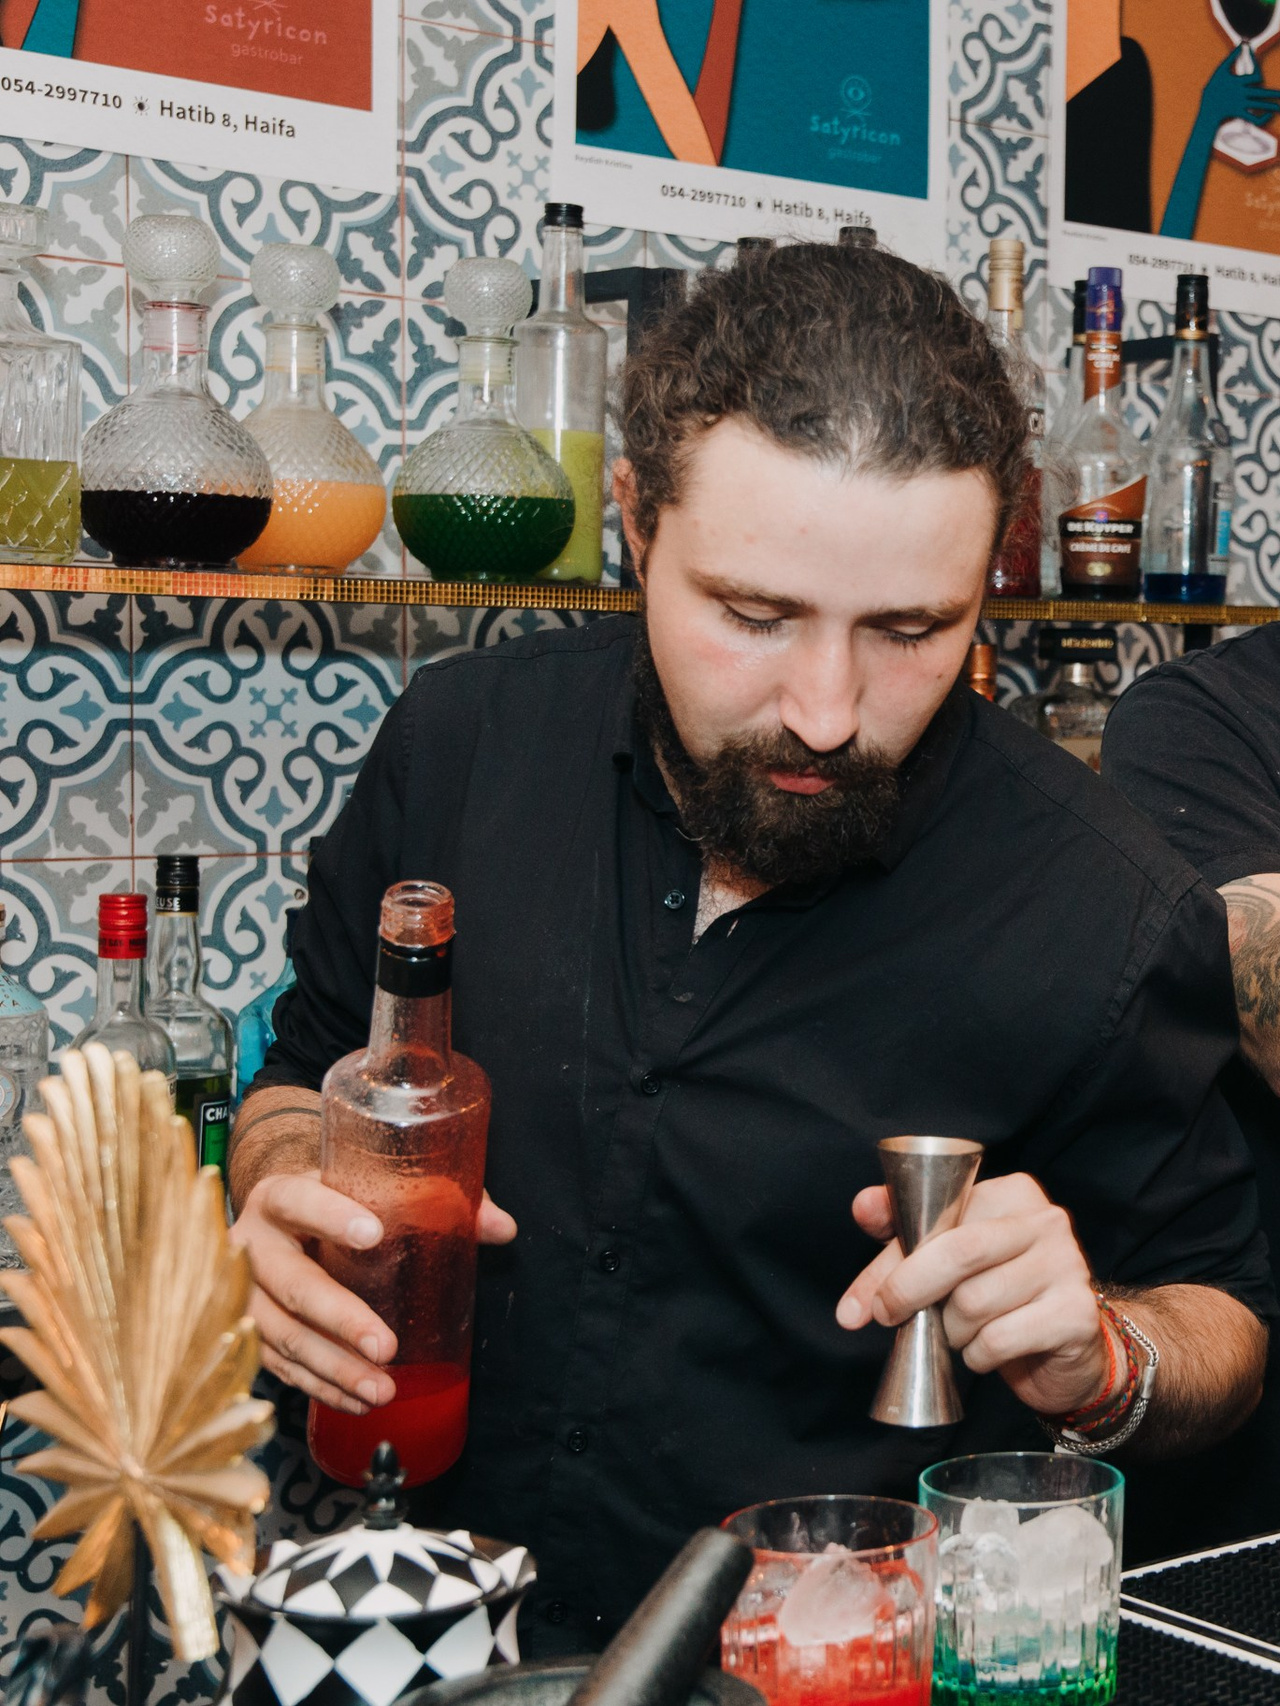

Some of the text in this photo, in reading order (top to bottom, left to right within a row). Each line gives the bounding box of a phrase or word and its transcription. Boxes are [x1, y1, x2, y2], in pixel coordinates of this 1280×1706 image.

[204, 4, 328, 45] Satyricon
[231, 43, 304, 65] gastrobar
[1, 76, 296, 138] 054-2997710 Hatib 8, Haifa
[809, 115, 901, 146] Satyricon
[660, 183, 747, 209] 054-2997710
[772, 200, 813, 218] Hatib
[834, 208, 873, 228] Haifa
